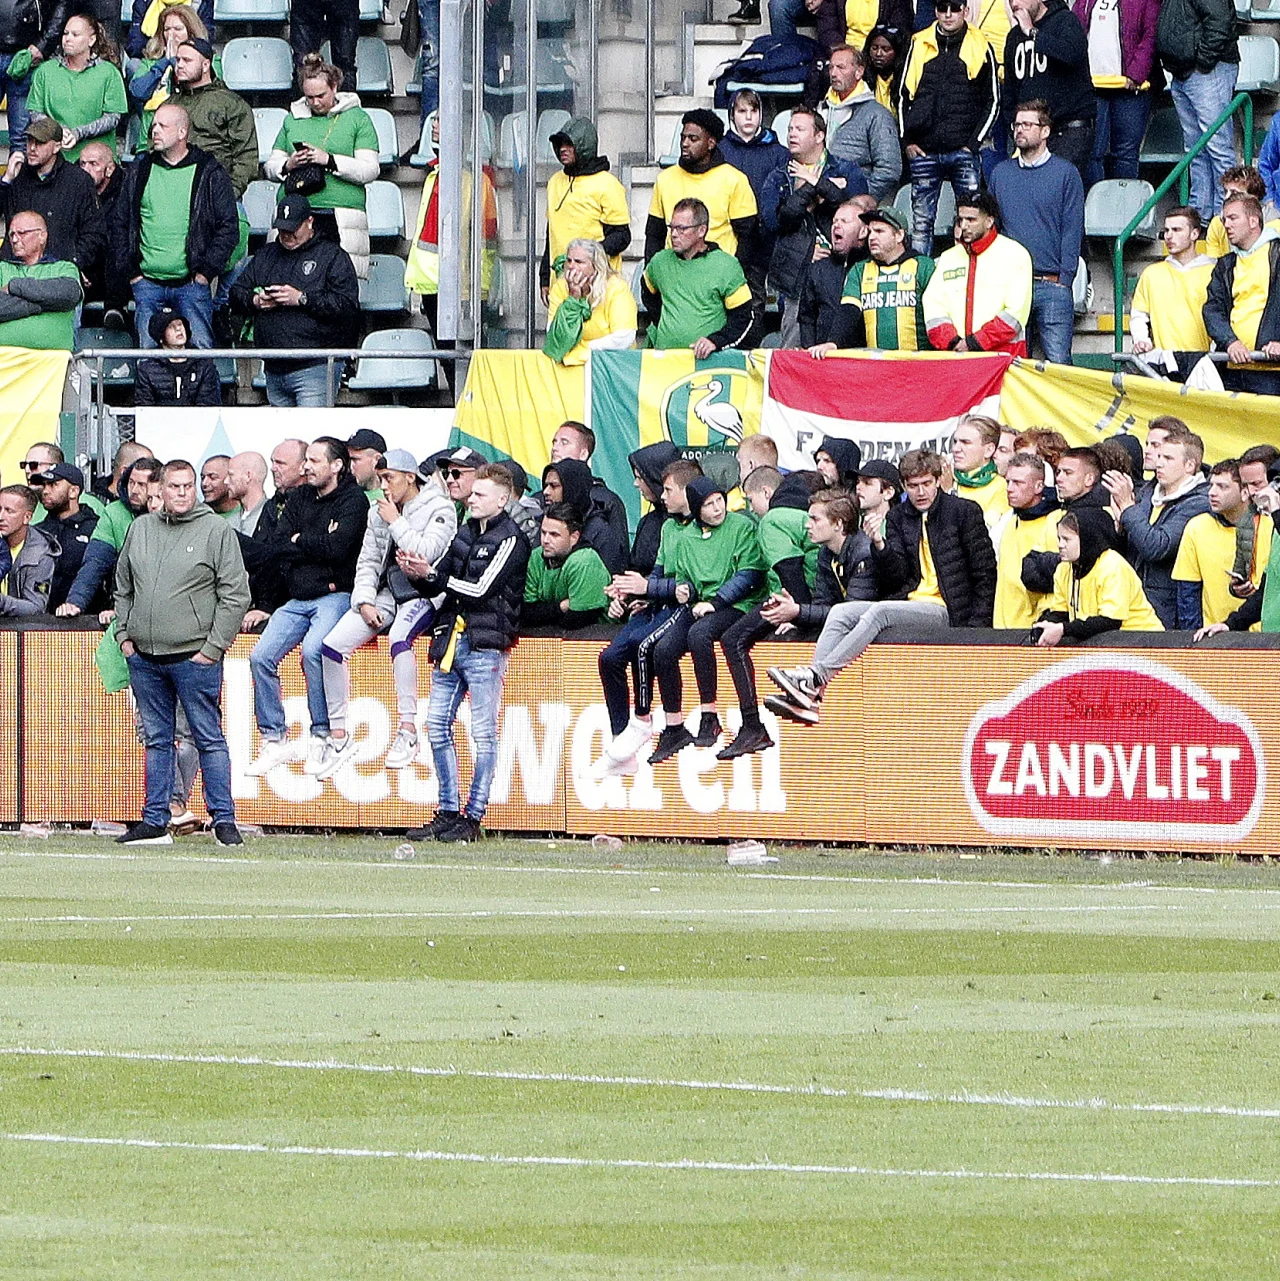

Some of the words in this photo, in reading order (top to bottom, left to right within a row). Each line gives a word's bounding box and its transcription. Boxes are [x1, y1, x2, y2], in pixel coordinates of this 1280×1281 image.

[861, 291, 884, 310] CARS
[884, 290, 917, 308] JEANS
[681, 450, 703, 460] ADO
[128, 657, 787, 814] leeswaren
[984, 739, 1241, 801] ZANDVLIET
